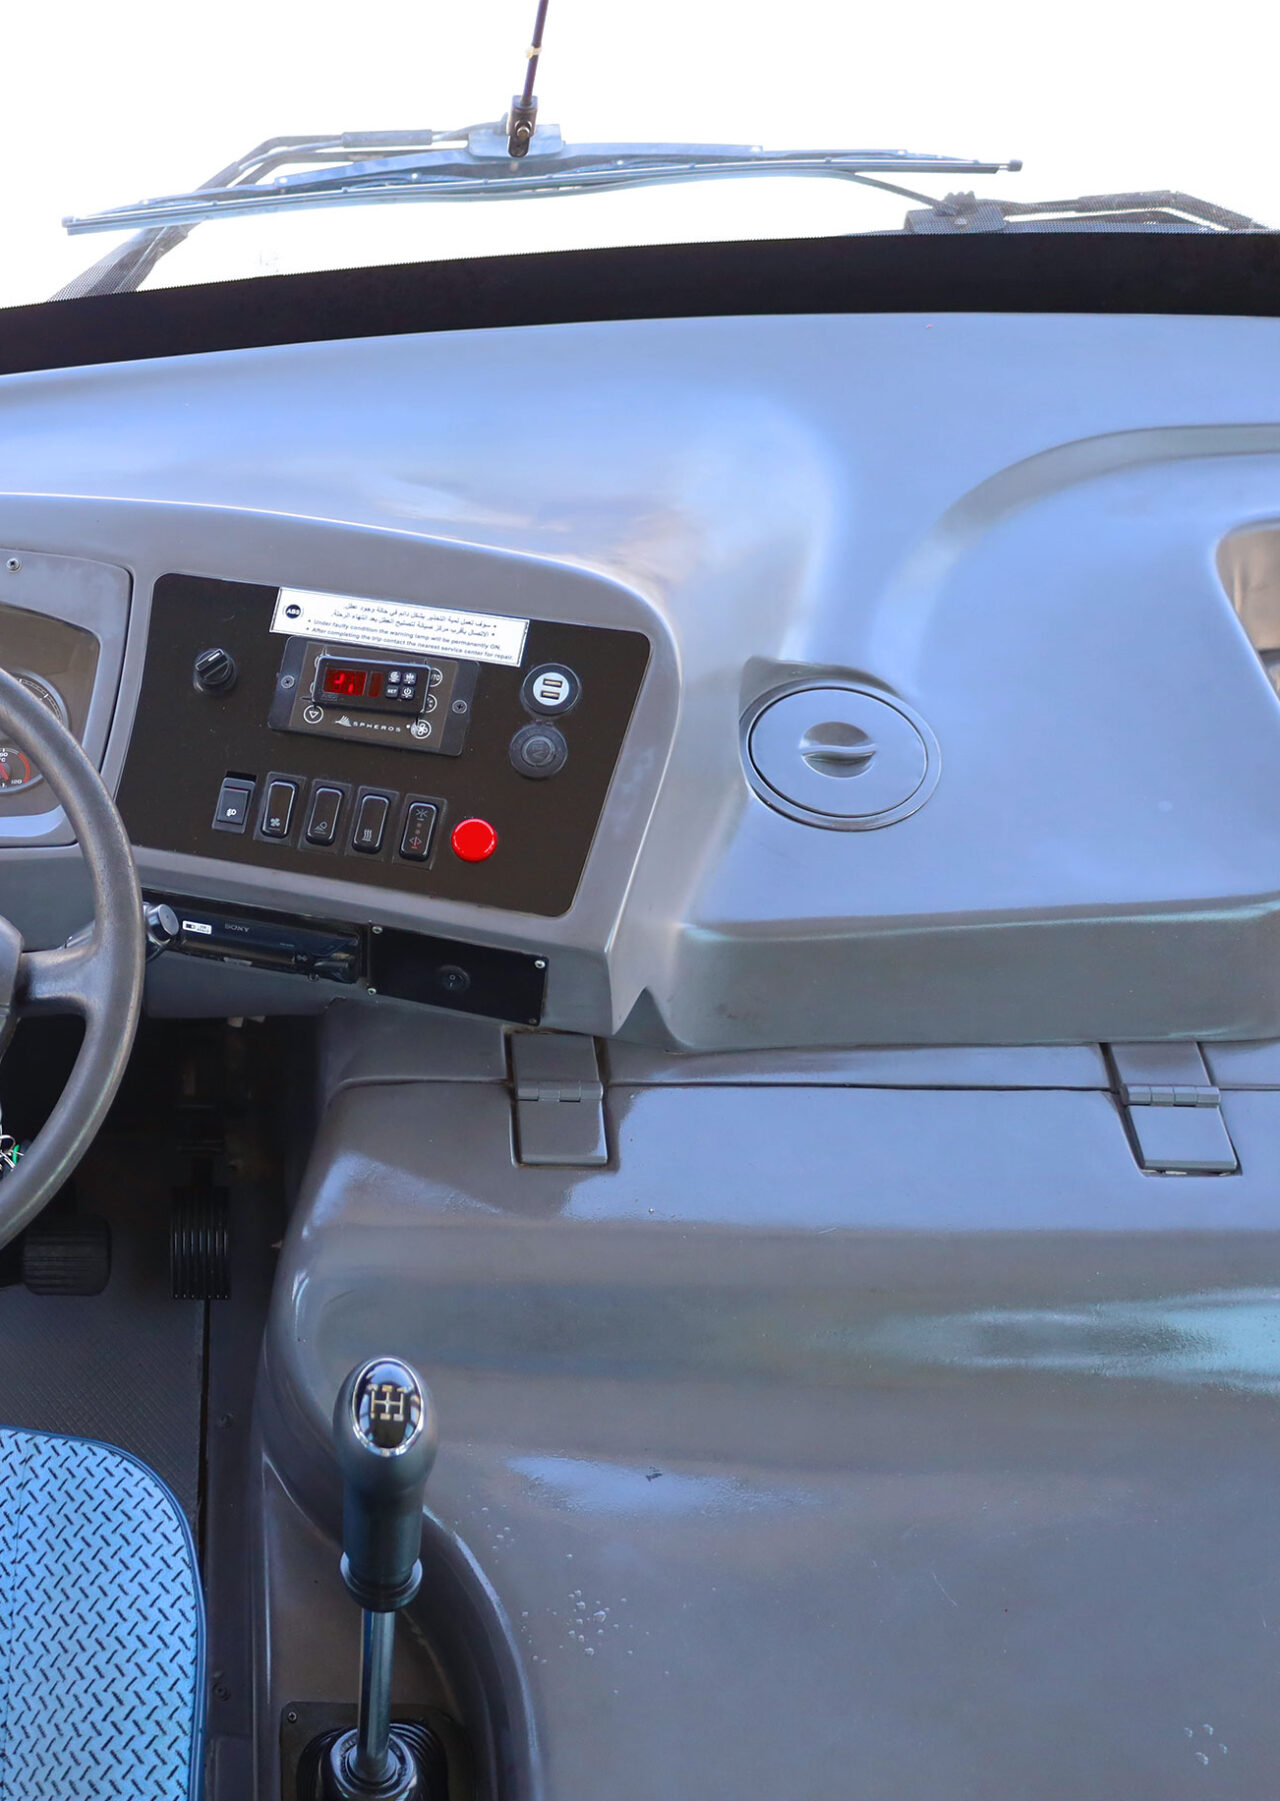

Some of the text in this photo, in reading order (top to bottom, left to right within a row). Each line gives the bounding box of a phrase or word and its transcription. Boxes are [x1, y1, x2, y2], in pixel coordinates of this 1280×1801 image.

[327, 630, 360, 639] completing
[451, 639, 488, 649] permanently
[352, 721, 402, 733] SPHEROS
[224, 924, 249, 933] SONY
